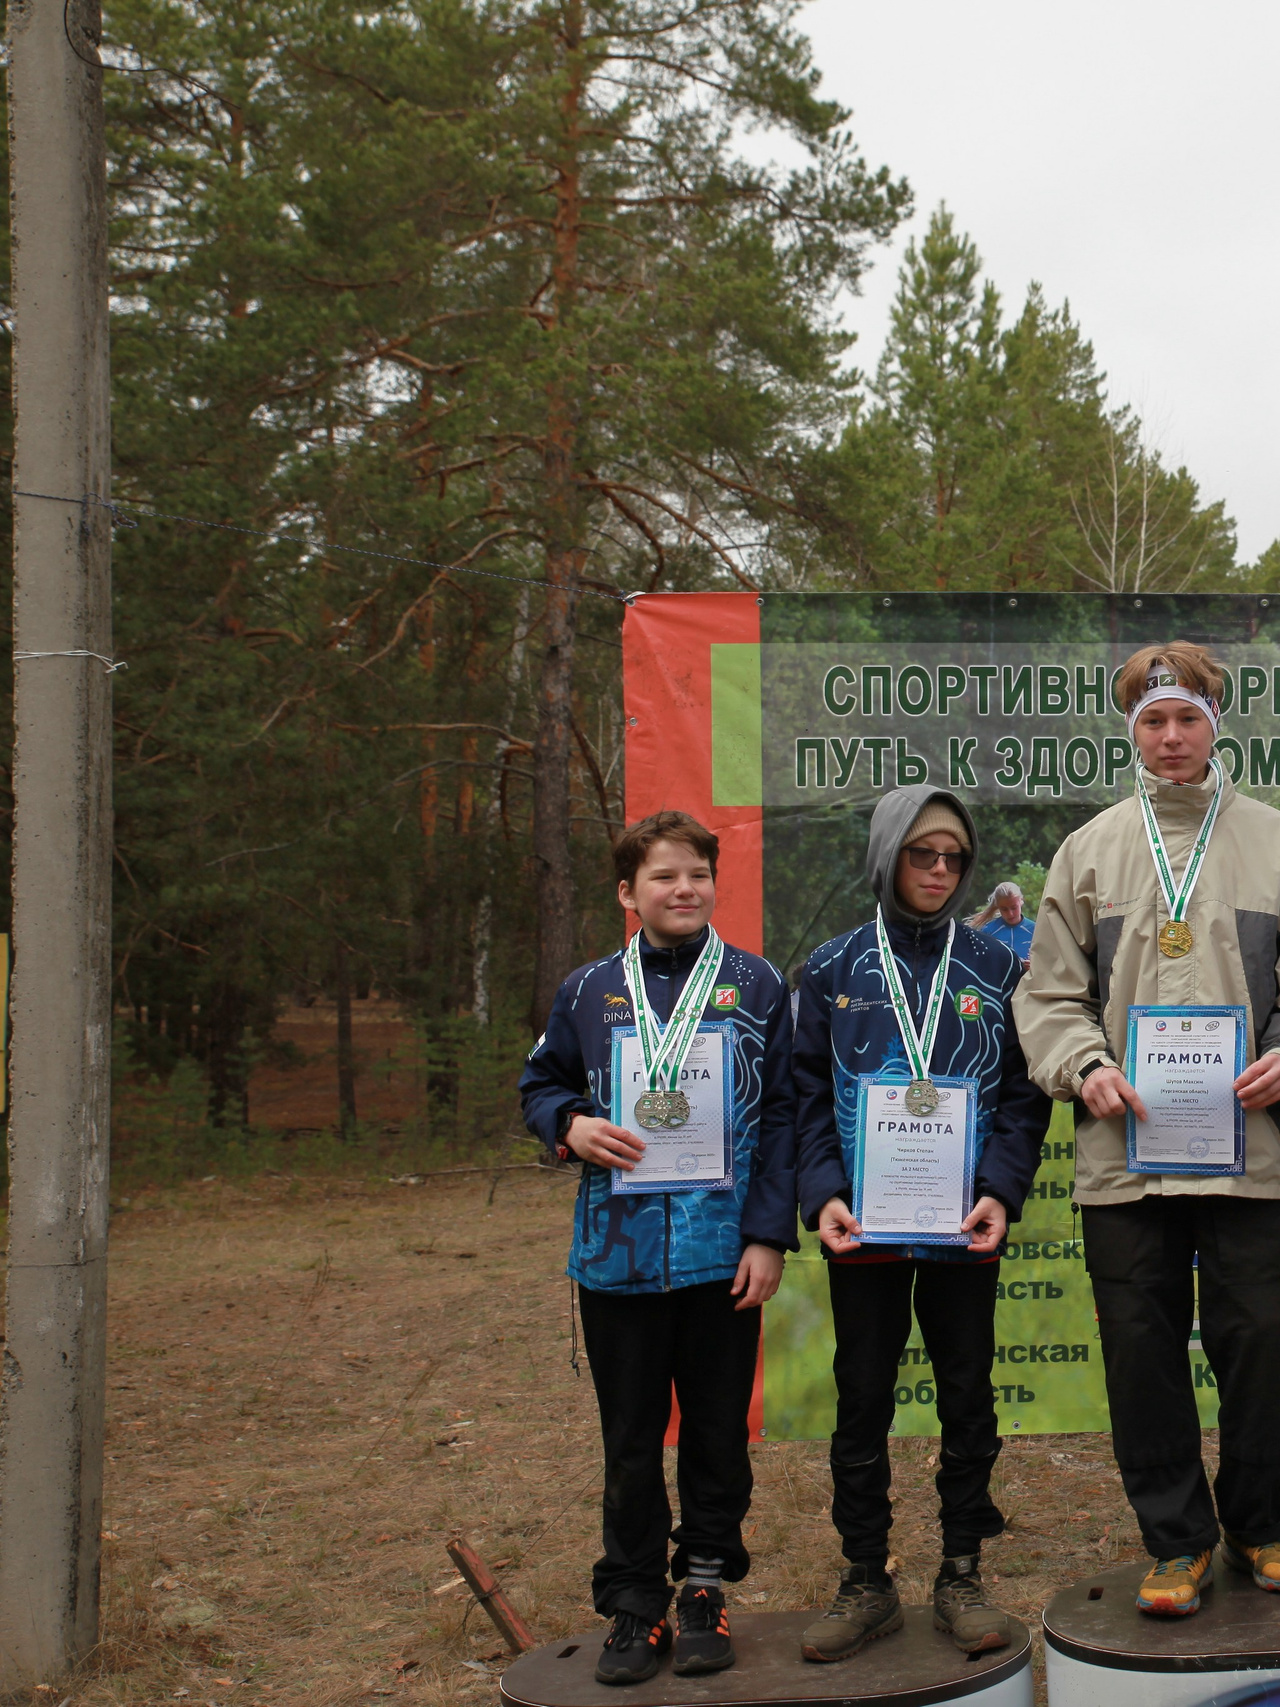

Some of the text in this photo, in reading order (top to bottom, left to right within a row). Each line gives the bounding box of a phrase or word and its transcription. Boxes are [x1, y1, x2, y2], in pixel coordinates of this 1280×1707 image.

[822, 665, 1127, 716] СПОРТИВН
[796, 736, 929, 788] ПУТЬ
[949, 737, 978, 787] К
[604, 1011, 632, 1023] DINA
[1148, 1053, 1223, 1064] ГРАМОТА
[878, 1121, 954, 1134] ГРАМОТА
